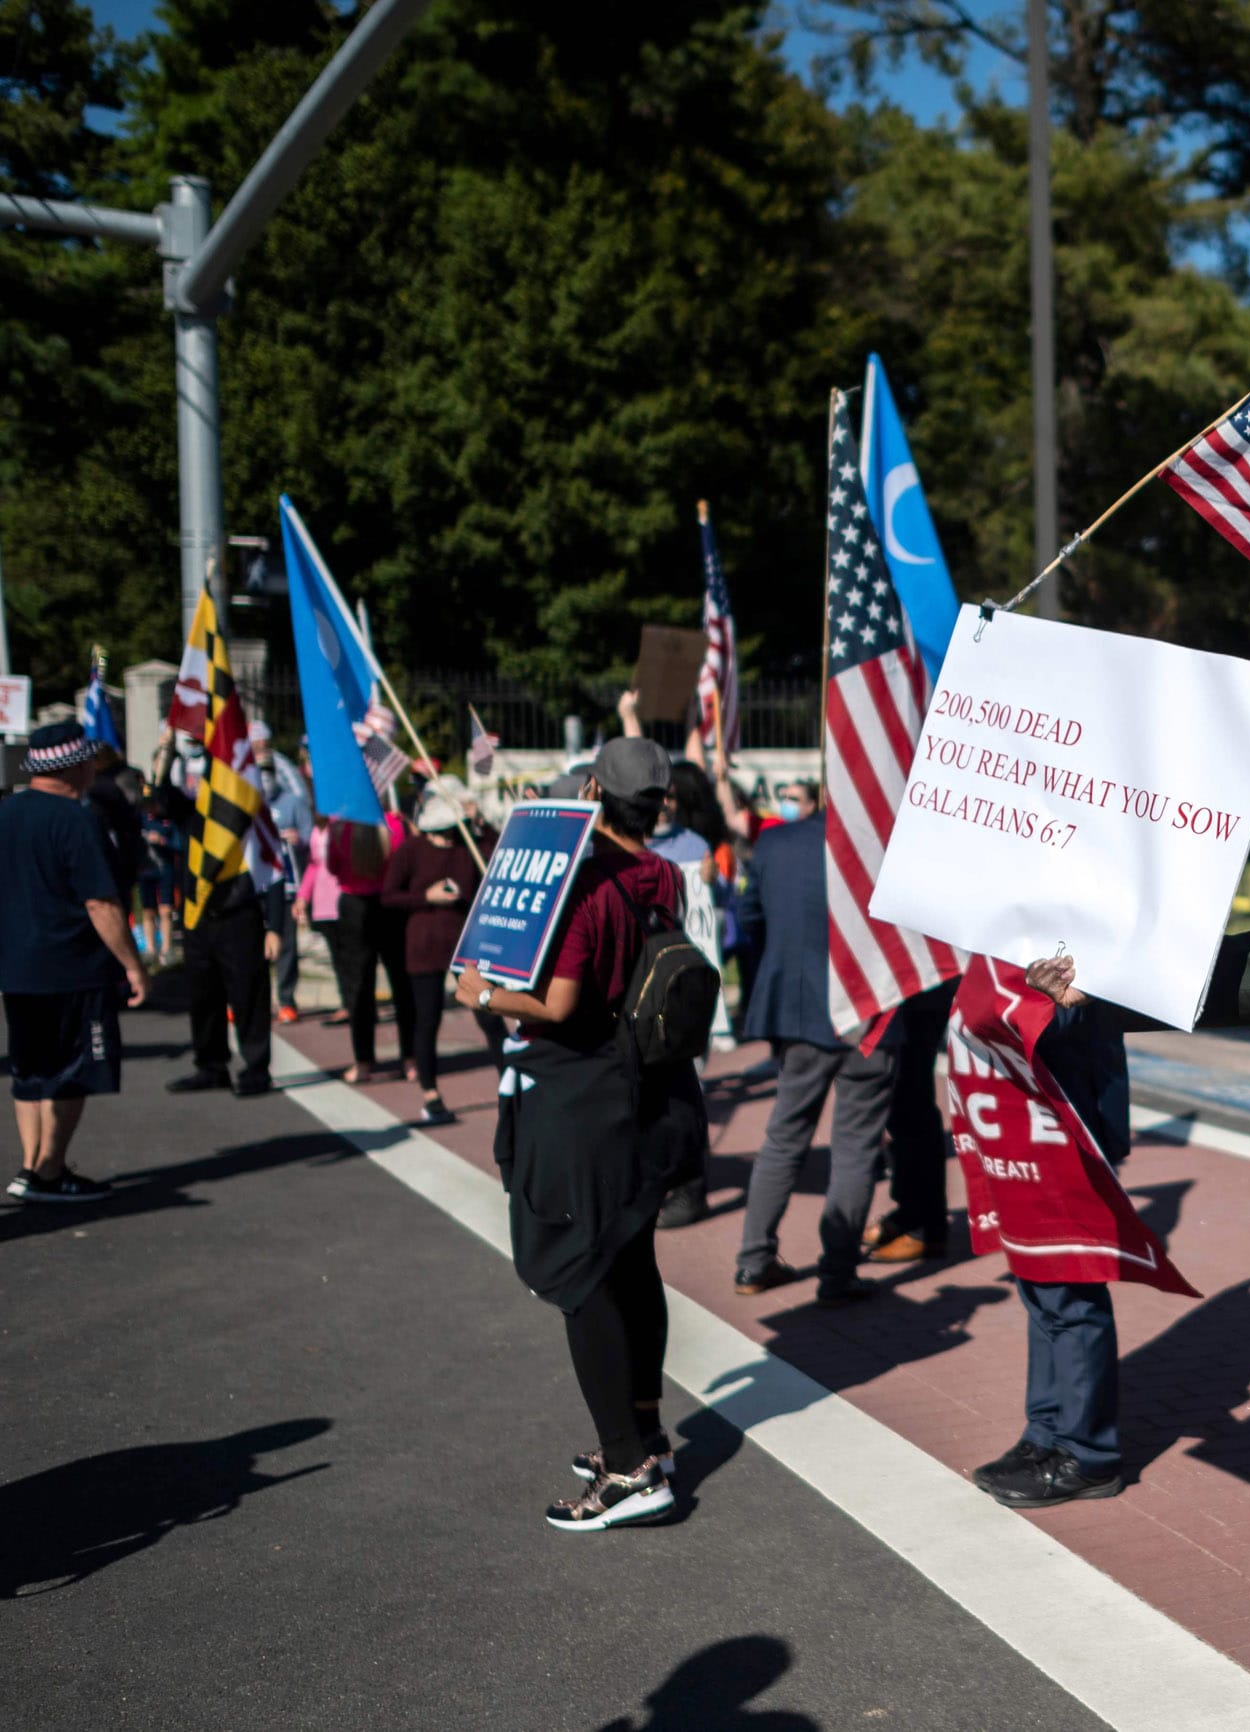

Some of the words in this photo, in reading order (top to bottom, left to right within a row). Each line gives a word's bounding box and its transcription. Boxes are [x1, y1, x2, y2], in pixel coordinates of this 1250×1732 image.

[935, 690, 1011, 729] 200,500
[1014, 709, 1082, 745] DEAD
[927, 735, 974, 769] YOU
[976, 749, 1036, 786] REAP
[1044, 765, 1116, 807] WHAT
[1122, 786, 1170, 822] YOU
[1172, 802, 1240, 841] SOW
[909, 782, 1038, 838] GALATIANS
[1040, 820, 1077, 848] 6:7
[489, 848, 570, 885] TRUMP
[481, 885, 547, 914] PENCE
[980, 1152, 1041, 1182] REAT!
